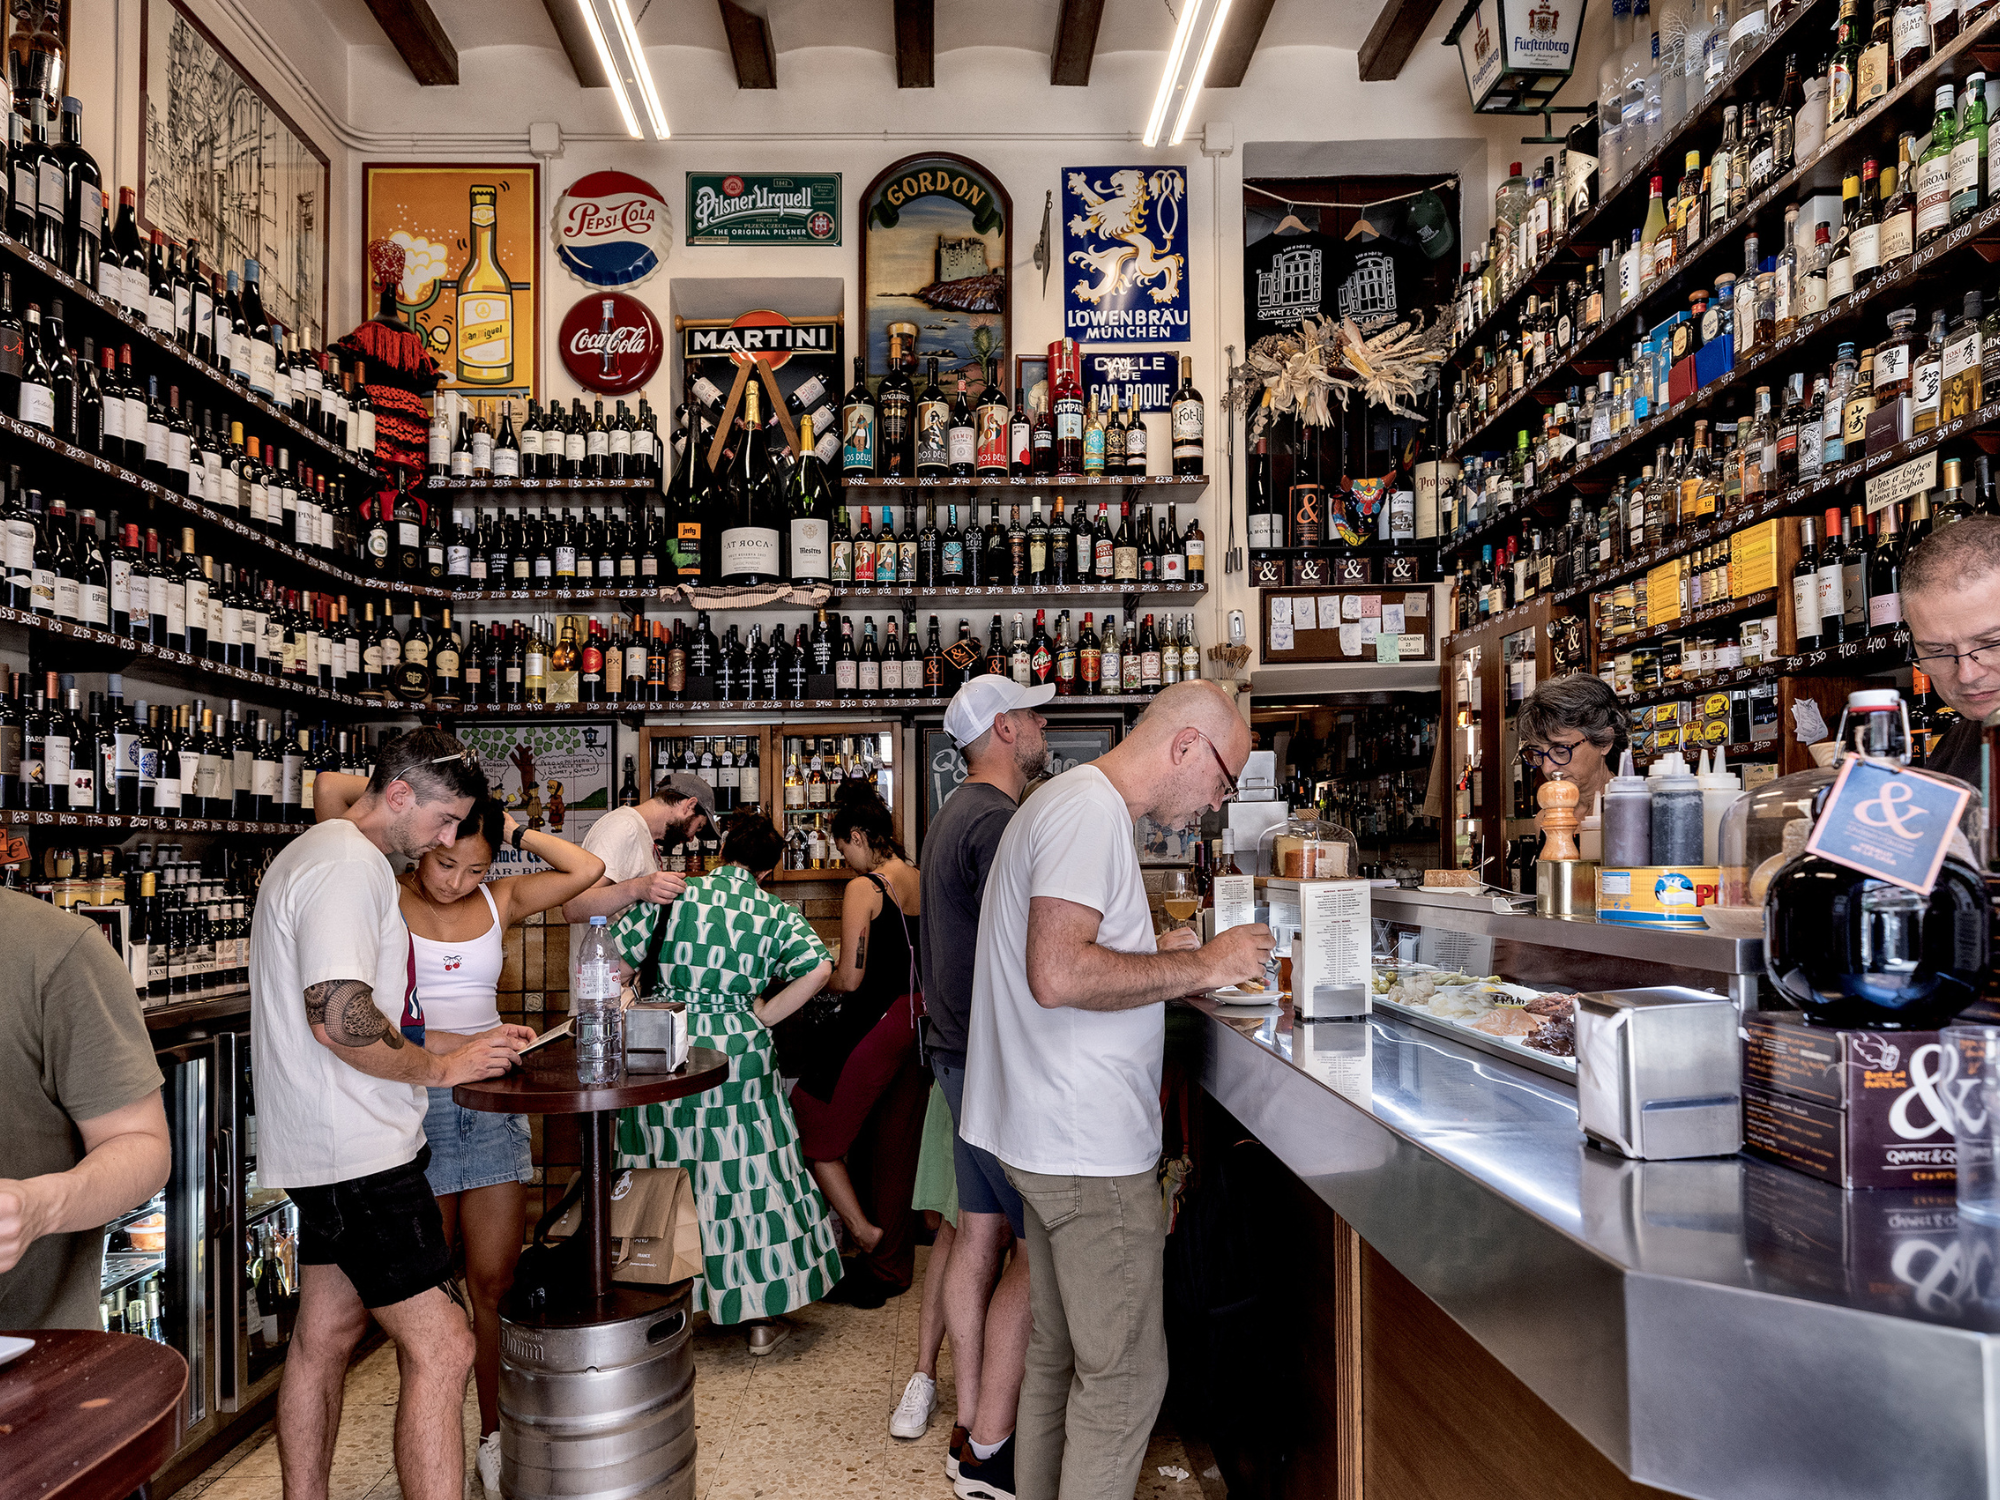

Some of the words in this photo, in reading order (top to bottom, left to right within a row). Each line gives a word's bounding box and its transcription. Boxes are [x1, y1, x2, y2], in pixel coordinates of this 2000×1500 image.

[887, 171, 987, 207] GORDON
[695, 186, 756, 228] Pilsner
[755, 184, 812, 216] Urquell
[1925, 192, 1944, 205] CASK
[713, 228, 730, 236] THE
[731, 228, 772, 236] ORIGINAL
[773, 228, 807, 236] PILSNER
[1067, 308, 1189, 328] LÖWENBRÄU
[570, 325, 647, 355] Coca-Cola
[694, 328, 827, 351] MARTINI
[1085, 325, 1171, 339] MÜNCHEN
[1945, 349, 1962, 360] TOKI
[1094, 357, 1166, 371] CALLE
[1119, 371, 1142, 381] DE
[1053, 401, 1084, 414] CAMPAR
[1903, 460, 1932, 478] Copes
[1419, 477, 1450, 491] Proos
[1899, 477, 1926, 493] copas
[1296, 493, 1323, 524] &
[1703, 499, 1713, 508] 12
[799, 546, 822, 555] Mestres
[1258, 561, 1278, 581] &
[1300, 560, 1320, 581] &
[1344, 558, 1364, 579] &
[1392, 557, 1412, 578] &
[1567, 627, 1580, 650] &
[606, 657, 620, 665] PX
[926, 660, 940, 675] &
[989, 659, 1002, 673] &
[1853, 781, 1930, 840] &
[1889, 1043, 1988, 1141] &
